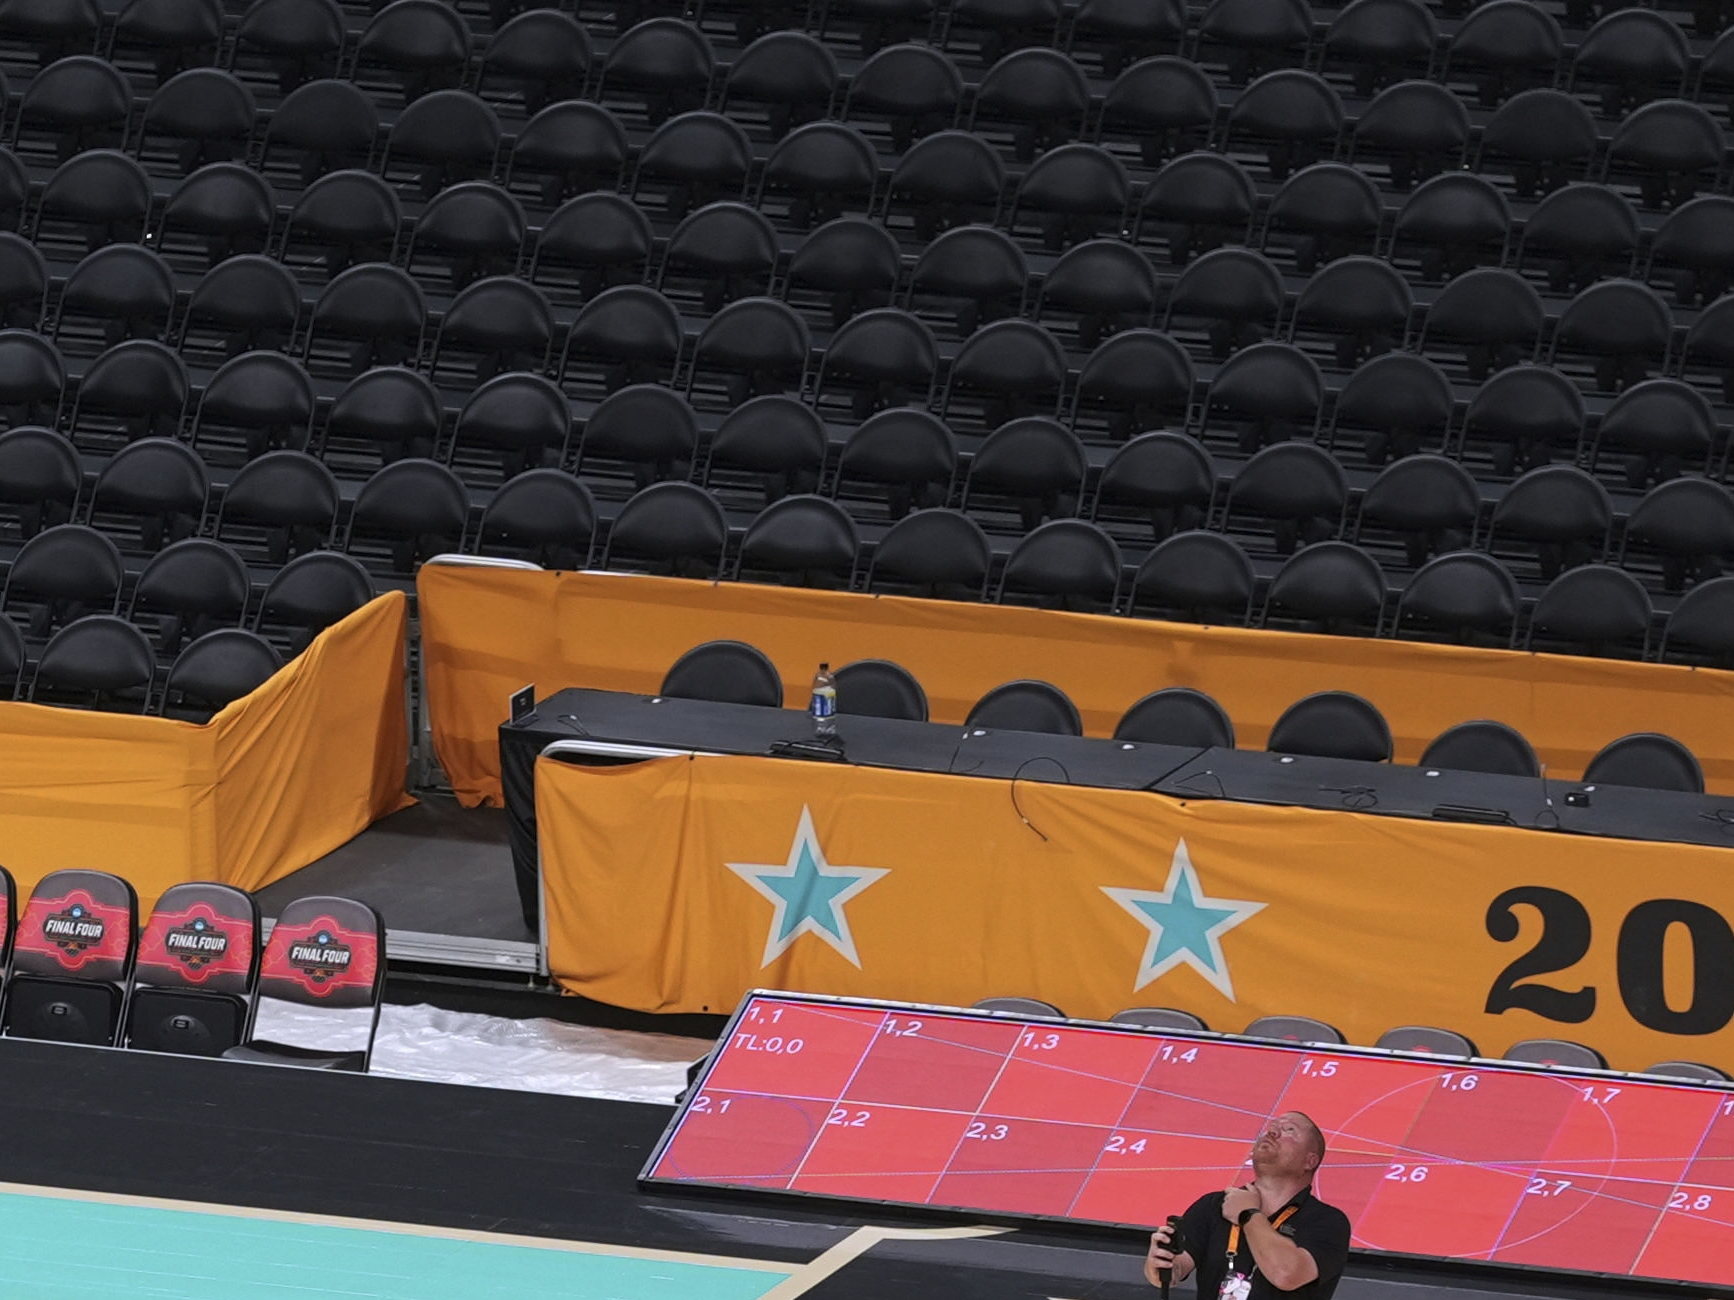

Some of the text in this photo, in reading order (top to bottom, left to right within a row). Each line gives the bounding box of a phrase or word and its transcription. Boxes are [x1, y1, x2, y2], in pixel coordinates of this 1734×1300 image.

[46, 920, 102, 937] FINAL FOUR
[169, 934, 225, 950] FINAL FOUR
[292, 947, 349, 963] FINAL FOUR
[749, 1005, 783, 1025] 1,1
[883, 1018, 922, 1041] 1,2
[733, 1033, 805, 1055] TL:0,0
[1022, 1031, 1061, 1052] 1,3
[1161, 1045, 1198, 1066] 1,4
[1300, 1058, 1339, 1080] 1,5
[1440, 1072, 1479, 1094] 1,6
[690, 1095, 731, 1116] 2,1
[1581, 1086, 1621, 1108] 1,7
[827, 1108, 872, 1130] 2,2
[965, 1121, 1010, 1143] 2,3
[1105, 1135, 1147, 1157] 2,4
[1384, 1163, 1429, 1184] 2,6
[1527, 1177, 1572, 1198] 2,7
[1668, 1191, 1712, 1212] 2,8
